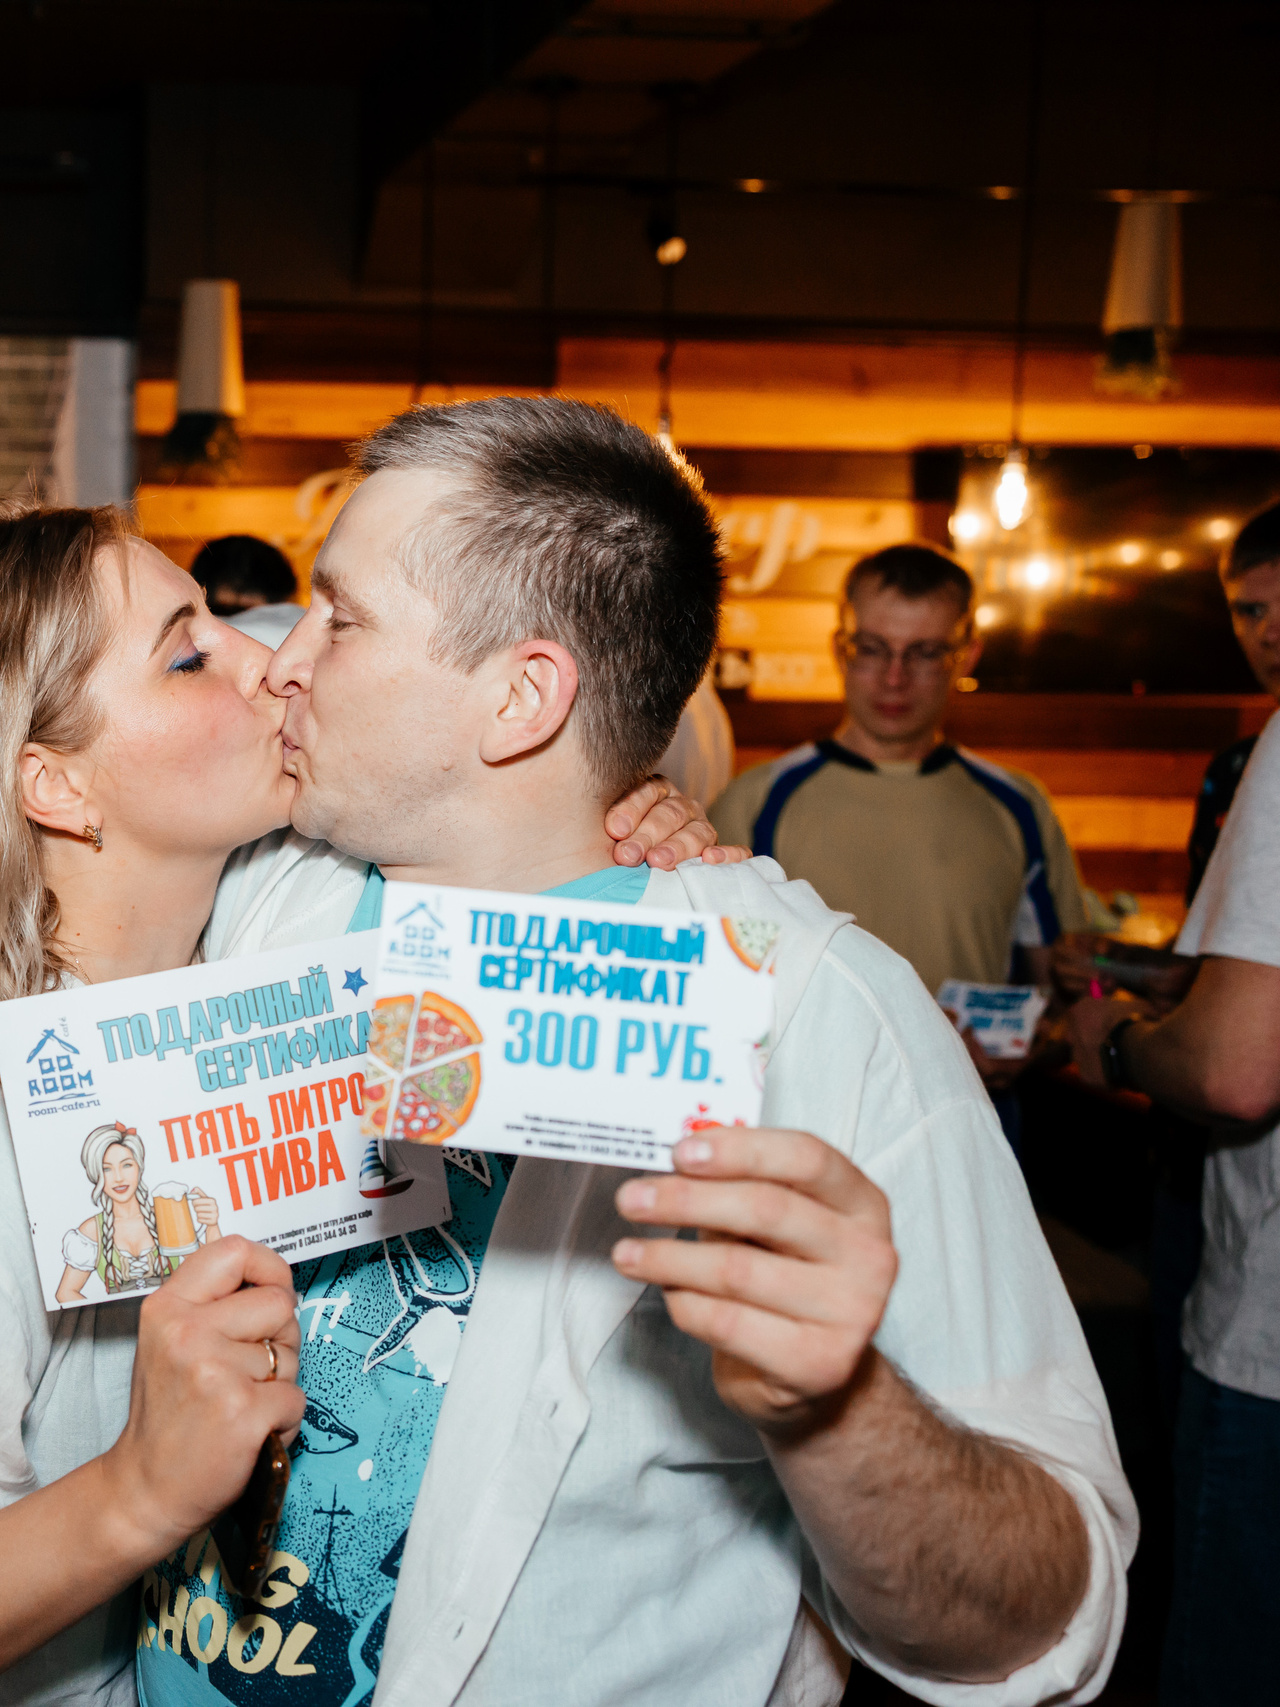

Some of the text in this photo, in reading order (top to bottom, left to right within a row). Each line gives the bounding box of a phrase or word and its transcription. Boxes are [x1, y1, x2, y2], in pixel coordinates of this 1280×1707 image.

[470, 909, 706, 965] ПОДАРОЧНЫЙ
[479, 953, 691, 1006] СЕРТИФИКАТ
[96, 964, 334, 1063] ПОДАРОЧНЫЙ
[504, 1008, 723, 1084] 300 РУБ.
[28, 1069, 94, 1097] ROOM
[195, 1011, 374, 1093] СЕРТИФИКА
[28, 1099, 101, 1118] room-cafe.ru
[158, 1072, 366, 1163] ПЯТЬ ЛИТРО
[218, 1129, 347, 1212] ПИВА
[304, 1233, 322, 1246] (343)
[323, 1229, 337, 1241] 344
[338, 1226, 348, 1237] 34
[348, 1223, 358, 1235] 33
